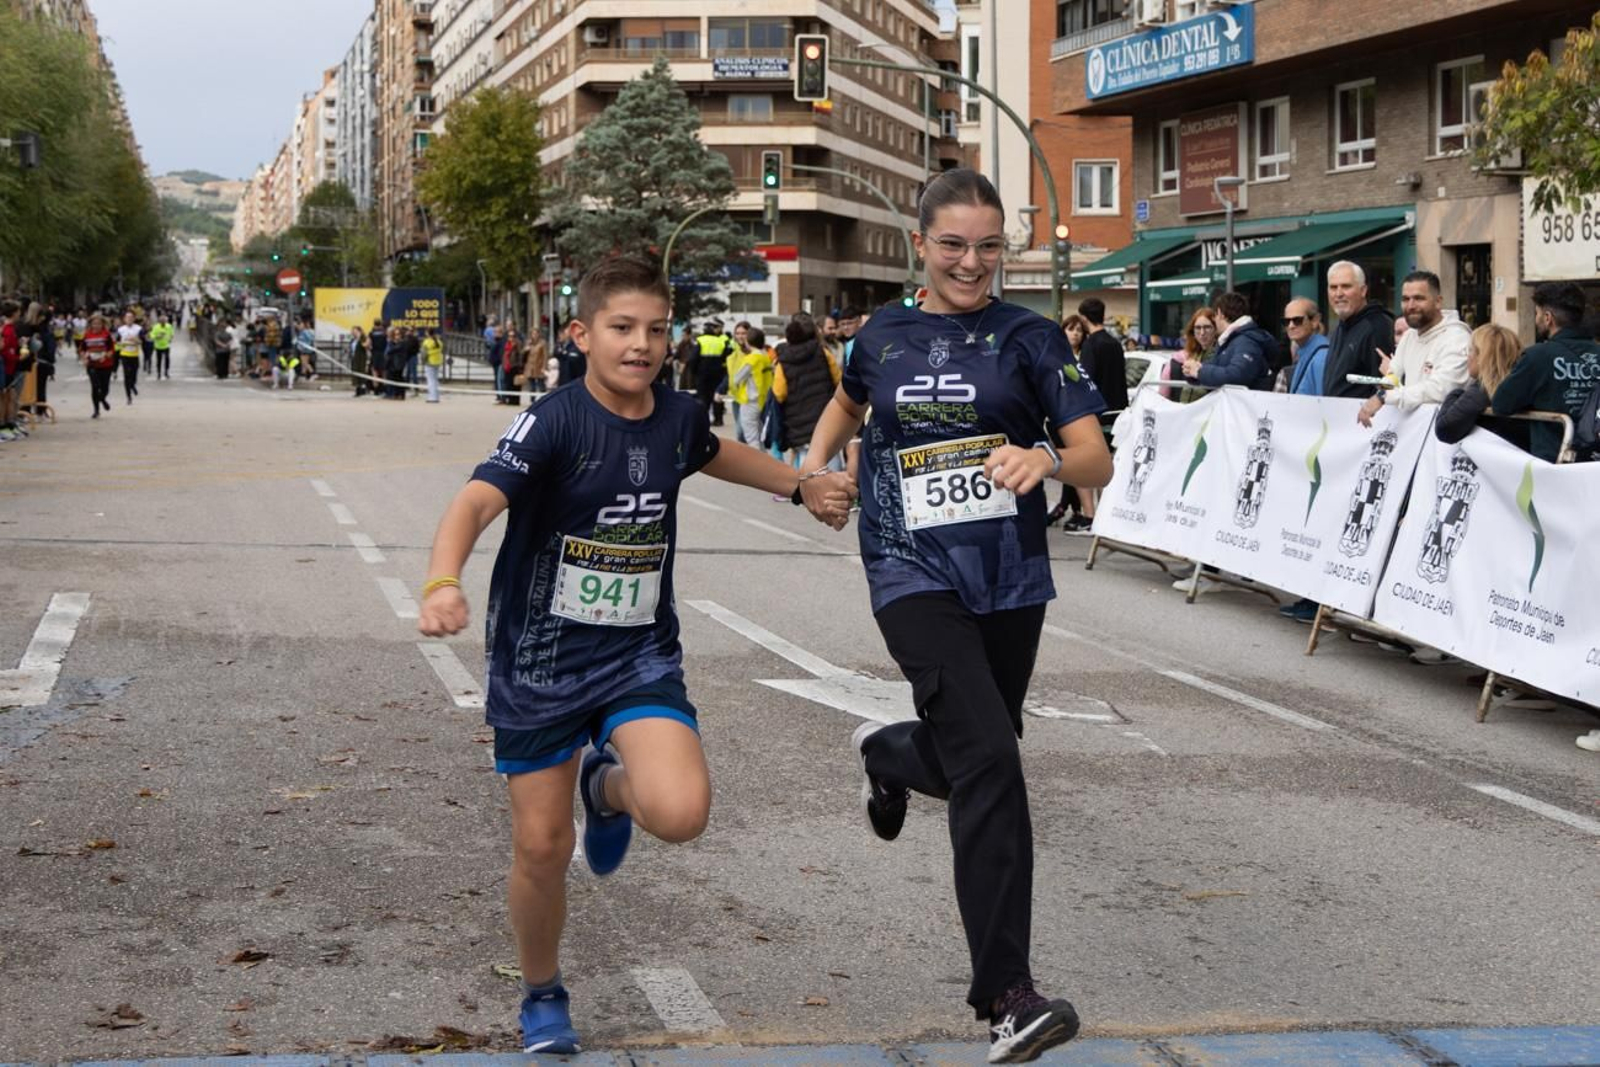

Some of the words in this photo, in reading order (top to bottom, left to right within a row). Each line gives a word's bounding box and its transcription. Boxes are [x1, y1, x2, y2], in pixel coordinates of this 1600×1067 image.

[1106, 39, 1159, 74] CLÍNICA
[1161, 21, 1220, 60] DENTAL
[1542, 214, 1575, 244] 958
[1581, 210, 1600, 241] 65
[405, 309, 418, 317] LO
[420, 308, 439, 317] QUE
[413, 299, 438, 308] TODO
[391, 319, 439, 328] NECESITAS
[895, 373, 977, 403] 25
[895, 403, 976, 413] CARRERA
[903, 451, 925, 469] XXV
[926, 445, 965, 456] CARRERA
[965, 438, 1004, 451] POPULAR
[937, 452, 960, 462] gran
[926, 470, 992, 507] 586
[596, 492, 667, 525] 25
[593, 523, 662, 534] CARRERA
[592, 532, 662, 544] POPULAR
[1215, 530, 1240, 547] CIUDAD
[567, 541, 593, 559] XXV
[594, 547, 633, 557] CARRERA
[604, 555, 626, 563] gran
[1343, 566, 1355, 581] DE
[579, 574, 641, 608] 941
[1392, 582, 1422, 604] CIUDAD
[1422, 593, 1436, 609] DE
[1488, 590, 1520, 611] Patronato
[1553, 612, 1565, 627] de
[1489, 610, 1523, 634] Deportes
[1524, 623, 1536, 637] de
